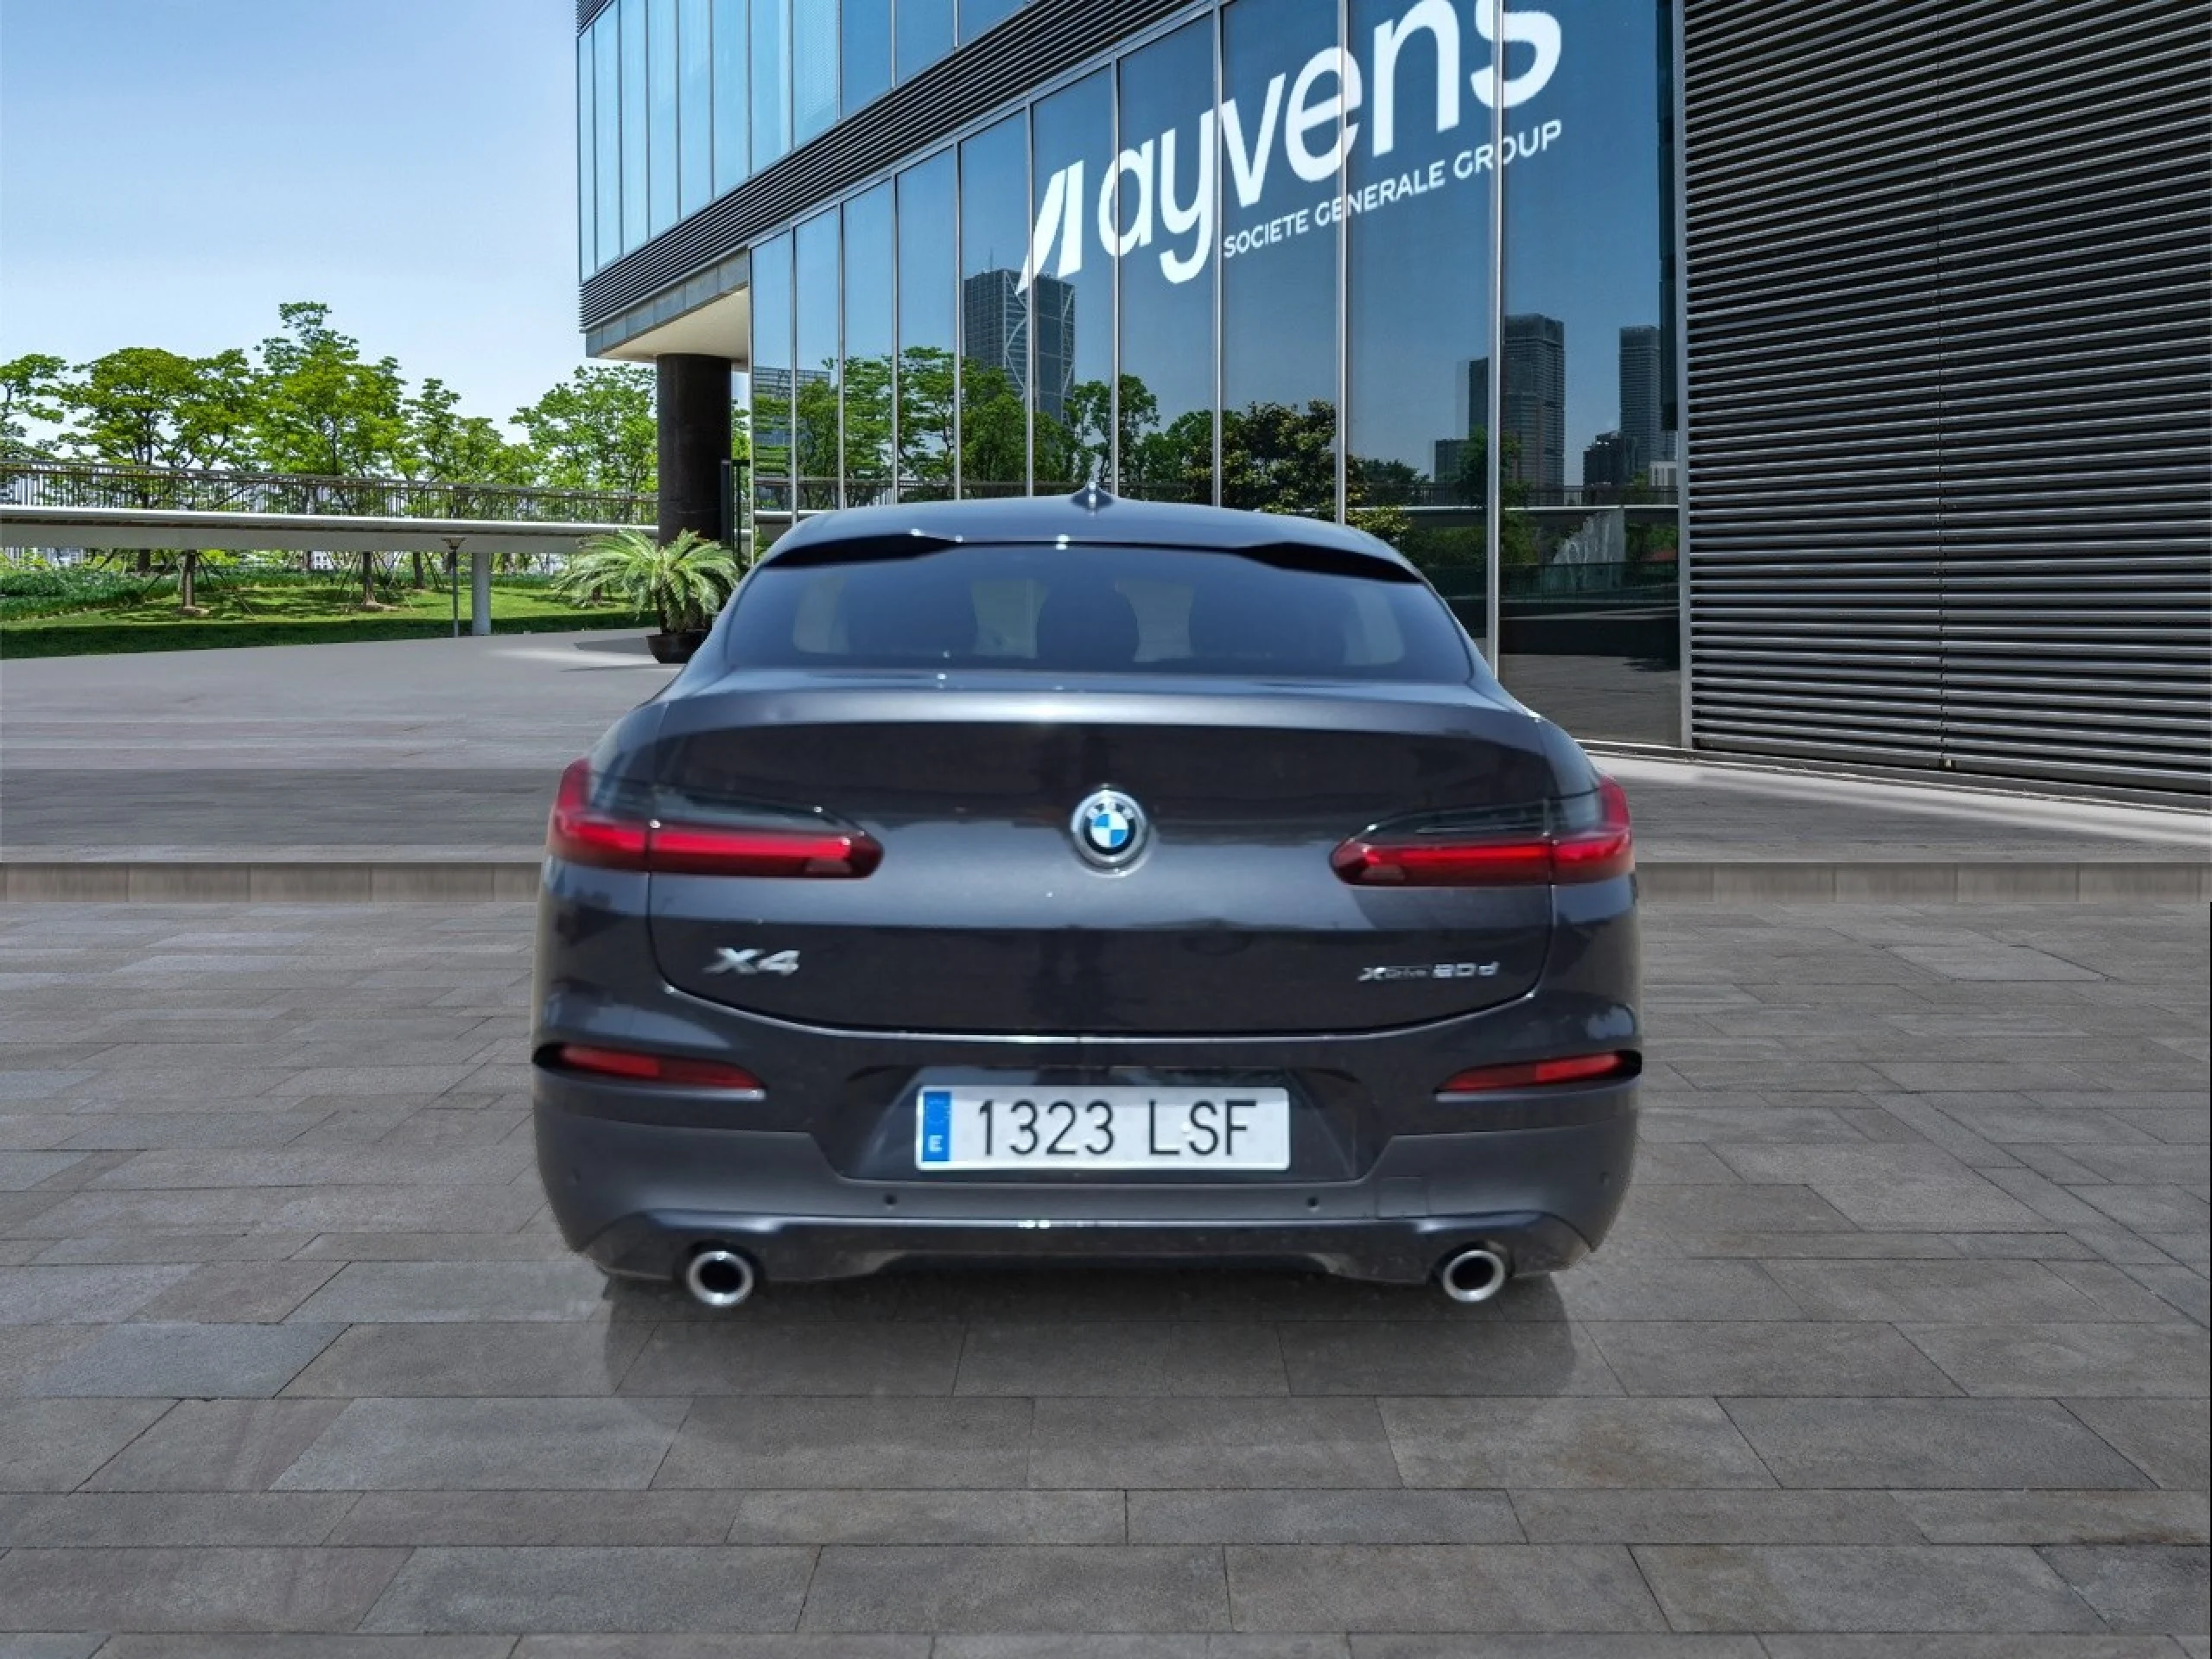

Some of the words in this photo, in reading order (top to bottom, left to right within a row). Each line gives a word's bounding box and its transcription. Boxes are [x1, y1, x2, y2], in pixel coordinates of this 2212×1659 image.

[1098, 0, 1560, 283] ayvens
[1224, 209, 1308, 257] SOCIETE
[1315, 161, 1446, 225] GENERALE
[1453, 119, 1561, 178] GROUP
[702, 947, 800, 976] X4
[928, 1135, 943, 1152] E
[979, 1099, 1115, 1156] 1323
[1148, 1099, 1257, 1156] LSF
